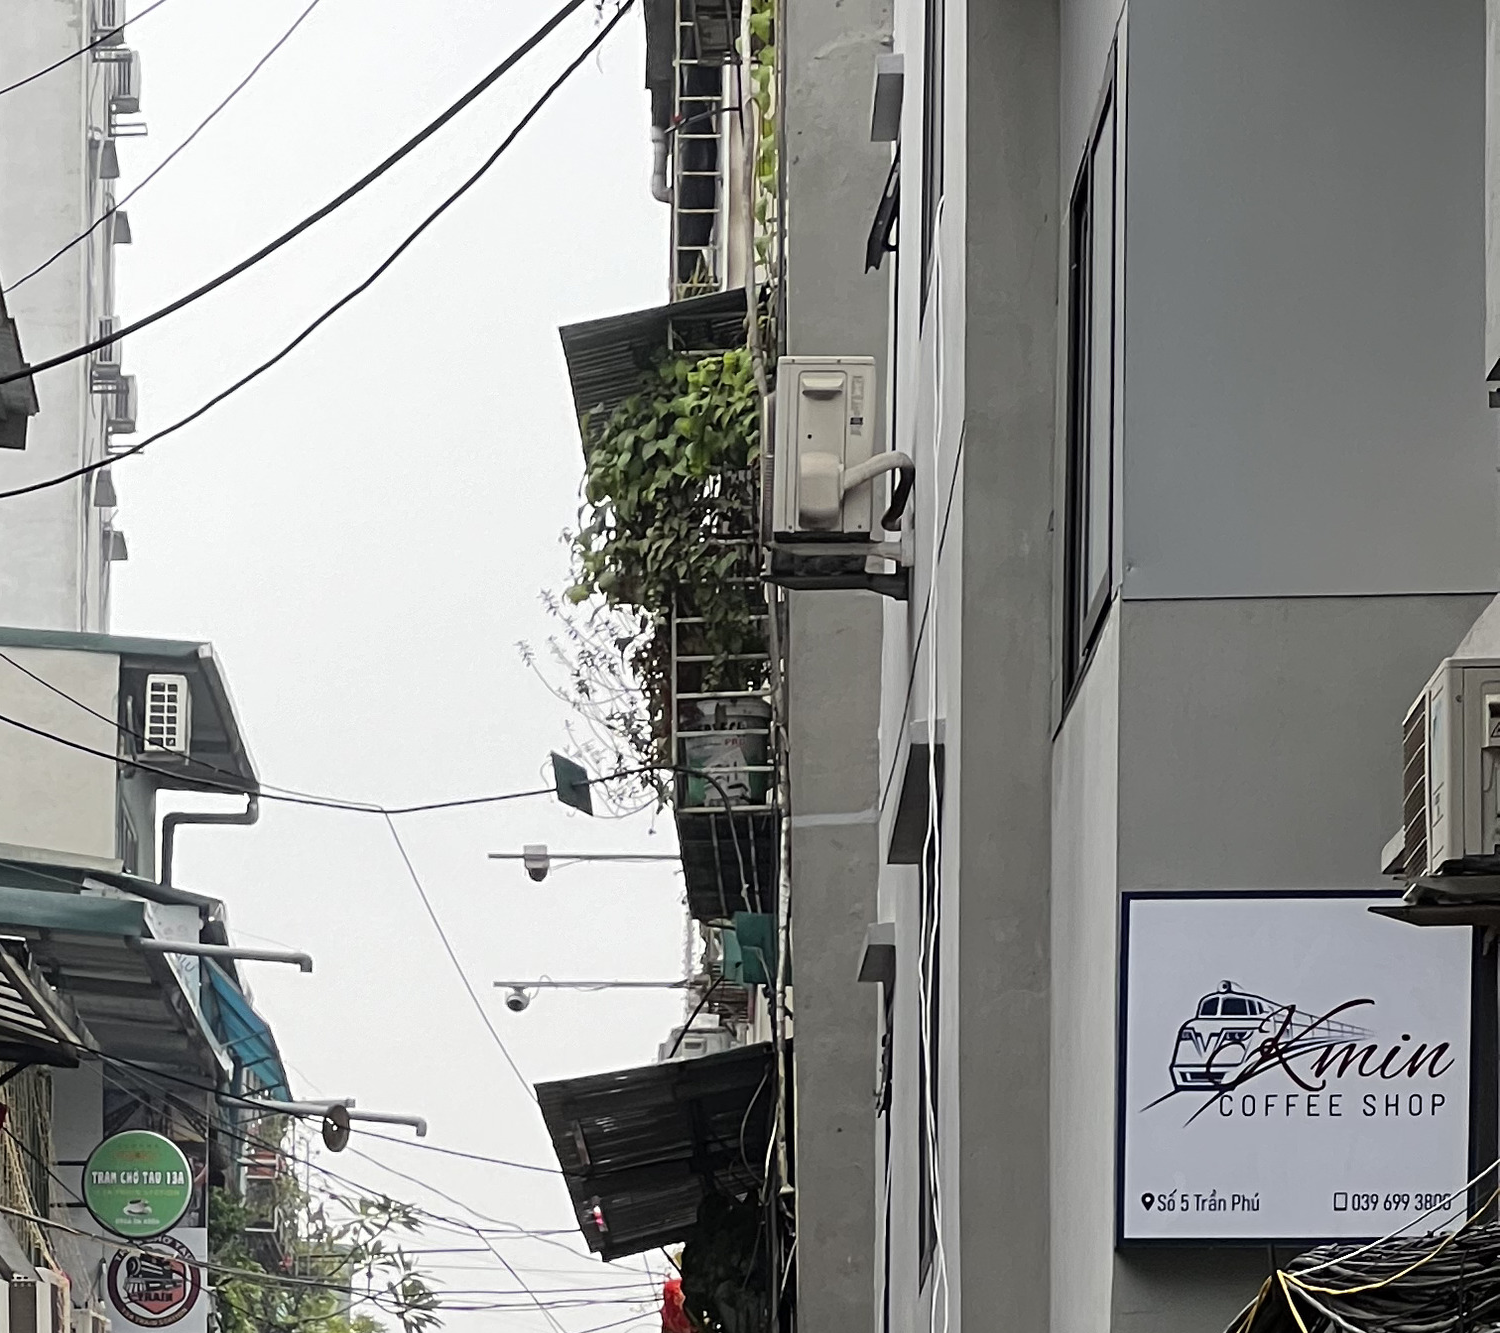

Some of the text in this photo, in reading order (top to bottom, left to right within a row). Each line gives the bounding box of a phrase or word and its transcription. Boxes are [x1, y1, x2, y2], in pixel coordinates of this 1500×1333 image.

[1206, 998, 1455, 1091] Kmin
[1219, 1093, 1447, 1117] COFFEE SHOP
[166, 1171, 185, 1185] 13A
[1157, 1188, 1178, 1212] Số
[1180, 1194, 1190, 1212] 5
[1231, 1192, 1261, 1212] Phú
[1351, 1193, 1379, 1212] 039
[1383, 1193, 1411, 1212] 699
